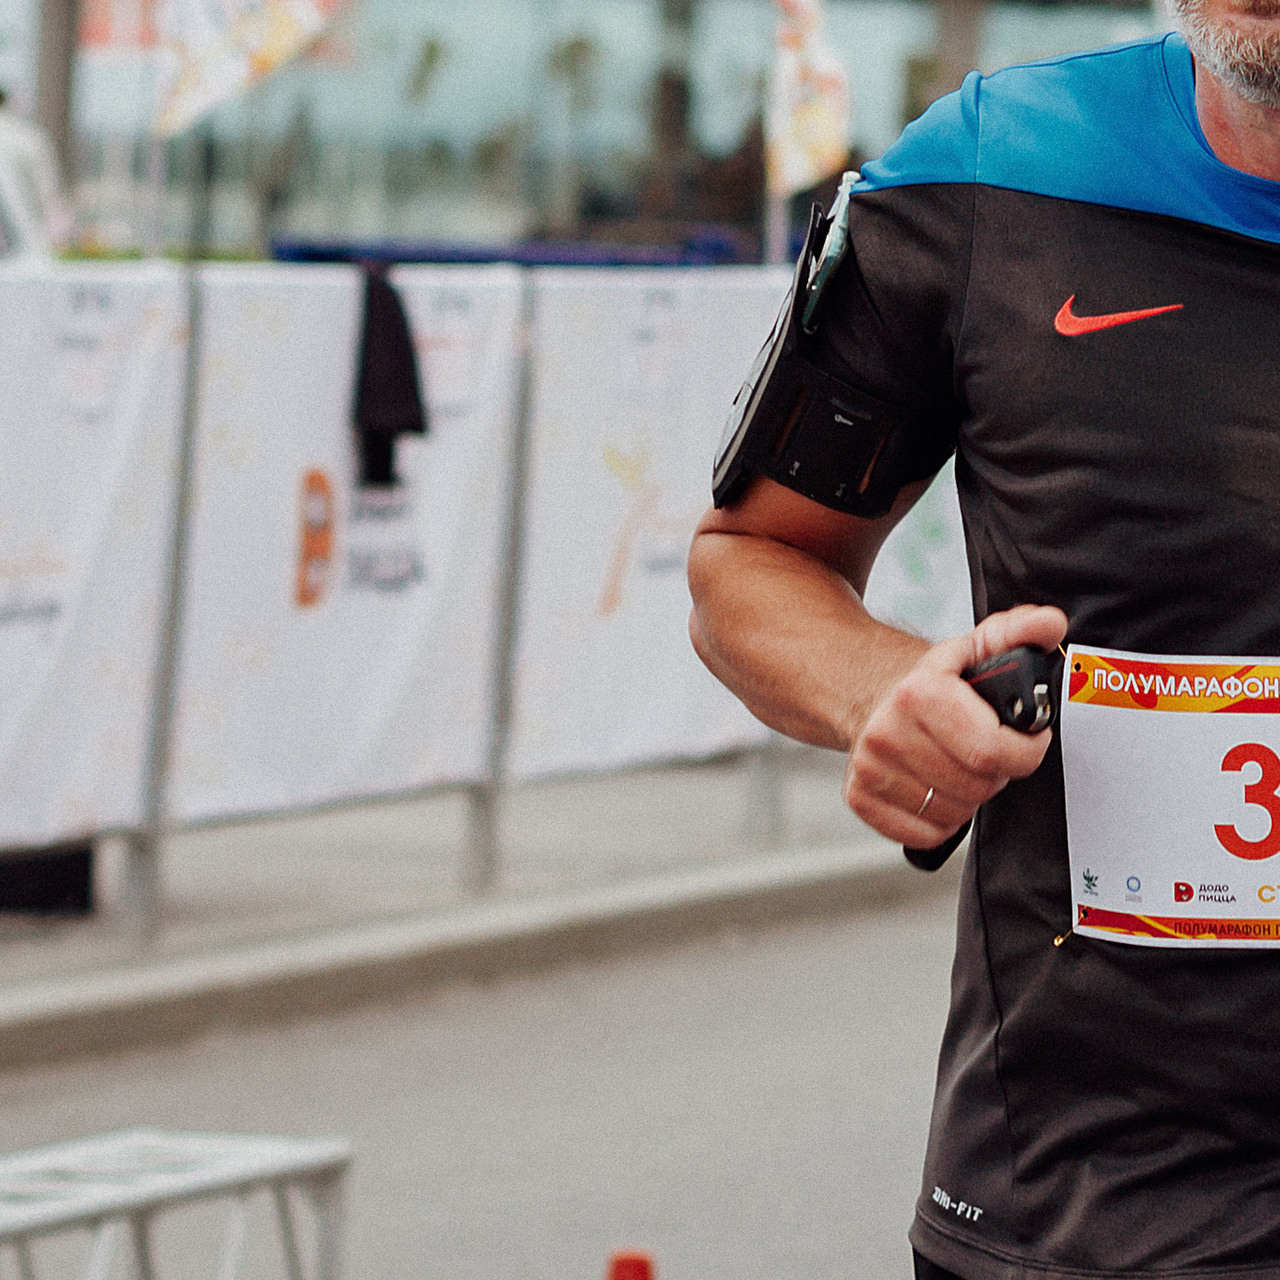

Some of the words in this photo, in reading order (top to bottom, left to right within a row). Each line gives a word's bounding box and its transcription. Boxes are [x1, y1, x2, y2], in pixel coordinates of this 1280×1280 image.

[1093, 668, 1280, 699] ПОЛУМАРАФОН
[1198, 883, 1230, 893] ДОДО
[1198, 894, 1237, 903] ПИЦЦА
[1173, 922, 1271, 936] ПОЛУМАРАФОН
